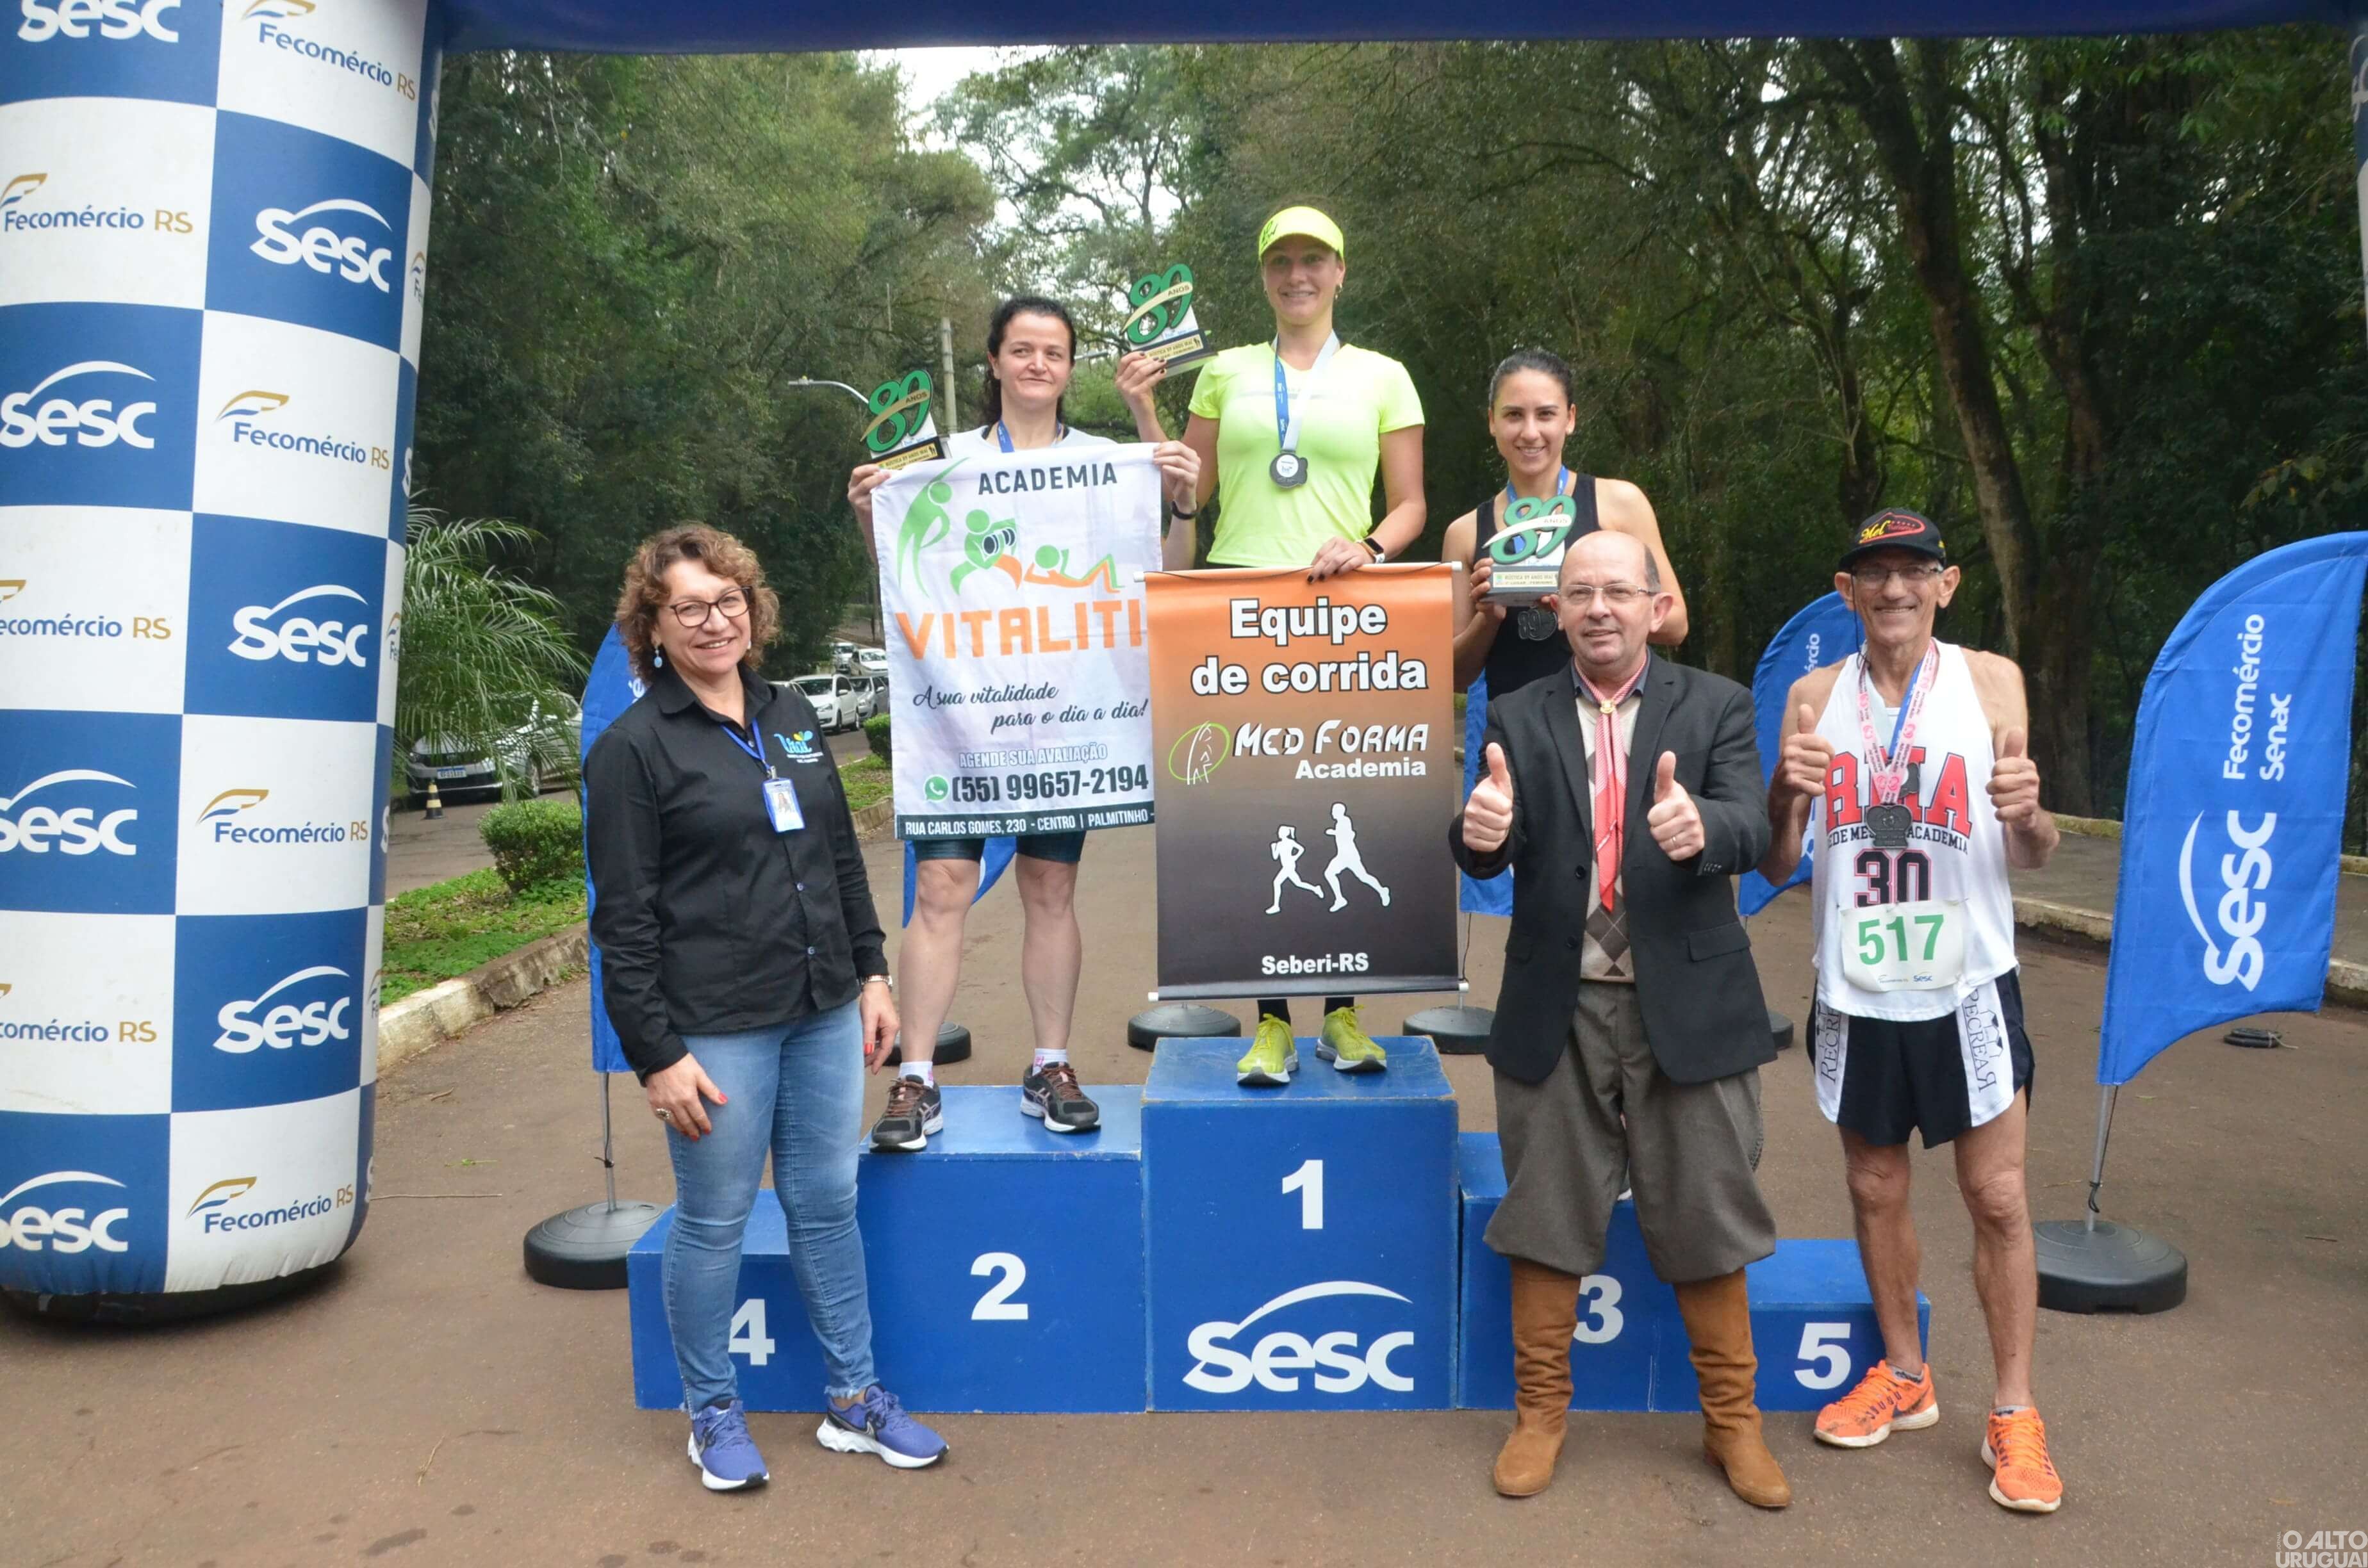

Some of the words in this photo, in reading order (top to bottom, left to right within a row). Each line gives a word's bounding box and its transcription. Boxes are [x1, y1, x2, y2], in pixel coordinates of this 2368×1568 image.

[259, 22, 393, 88] Fecomércio
[397, 72, 416, 102] RS
[4, 205, 144, 233] Fecomércio
[154, 209, 193, 234] RS
[1126, 263, 1194, 345] 89
[1167, 285, 1190, 297] ANOS
[866, 370, 933, 452] 89
[905, 391, 928, 404] ANOS
[233, 422, 366, 464] Fecomércio
[371, 446, 390, 470] RS
[978, 462, 1118, 496] ACADEMIA
[0, 613, 123, 637] ecomércio
[133, 617, 171, 639] RS
[894, 598, 1143, 661] VITALITI
[1229, 596, 1388, 646] Equipe
[935, 690, 966, 706] sua
[970, 681, 1059, 704] vitalidade
[1190, 655, 1249, 696] de
[1261, 650, 1429, 694] corrida
[2223, 614, 2265, 780] Fecomércio
[991, 709, 1036, 735] para
[1041, 712, 1055, 724] o
[1059, 705, 1089, 723] dia
[1093, 710, 1106, 721] a
[1111, 698, 1149, 719] dia!
[2260, 693, 2292, 781] Senac
[959, 749, 1008, 769] AGENDE
[1008, 749, 1035, 765] SUA
[1037, 742, 1108, 764] AVALIAÇÃO
[1295, 757, 1427, 780] Academia
[952, 775, 1000, 802] (55)
[1007, 764, 1149, 801] 99657-2194
[215, 822, 345, 843] Fecomércio
[350, 821, 368, 840] RS
[905, 821, 925, 835] RUA
[928, 820, 967, 835] CARLOS
[968, 819, 1005, 835] GOMES,
[1007, 818, 1026, 833] 230
[1037, 815, 1075, 831] CENTRO
[1089, 808, 1148, 827] PALMITINHO
[1854, 849, 1932, 908] 30
[1262, 952, 1369, 975] Seberi-RS
[1858, 914, 1945, 965] 517
[0, 1018, 108, 1042] omércio
[119, 1021, 157, 1043] RS
[204, 1196, 331, 1234] Fecomércio
[336, 1183, 354, 1209] RS
[1282, 1159, 1323, 1229] 1
[971, 1252, 1028, 1321] 2
[1573, 1275, 1624, 1344] 3
[728, 1298, 775, 1366] 4
[1794, 1323, 1851, 1390] 5
